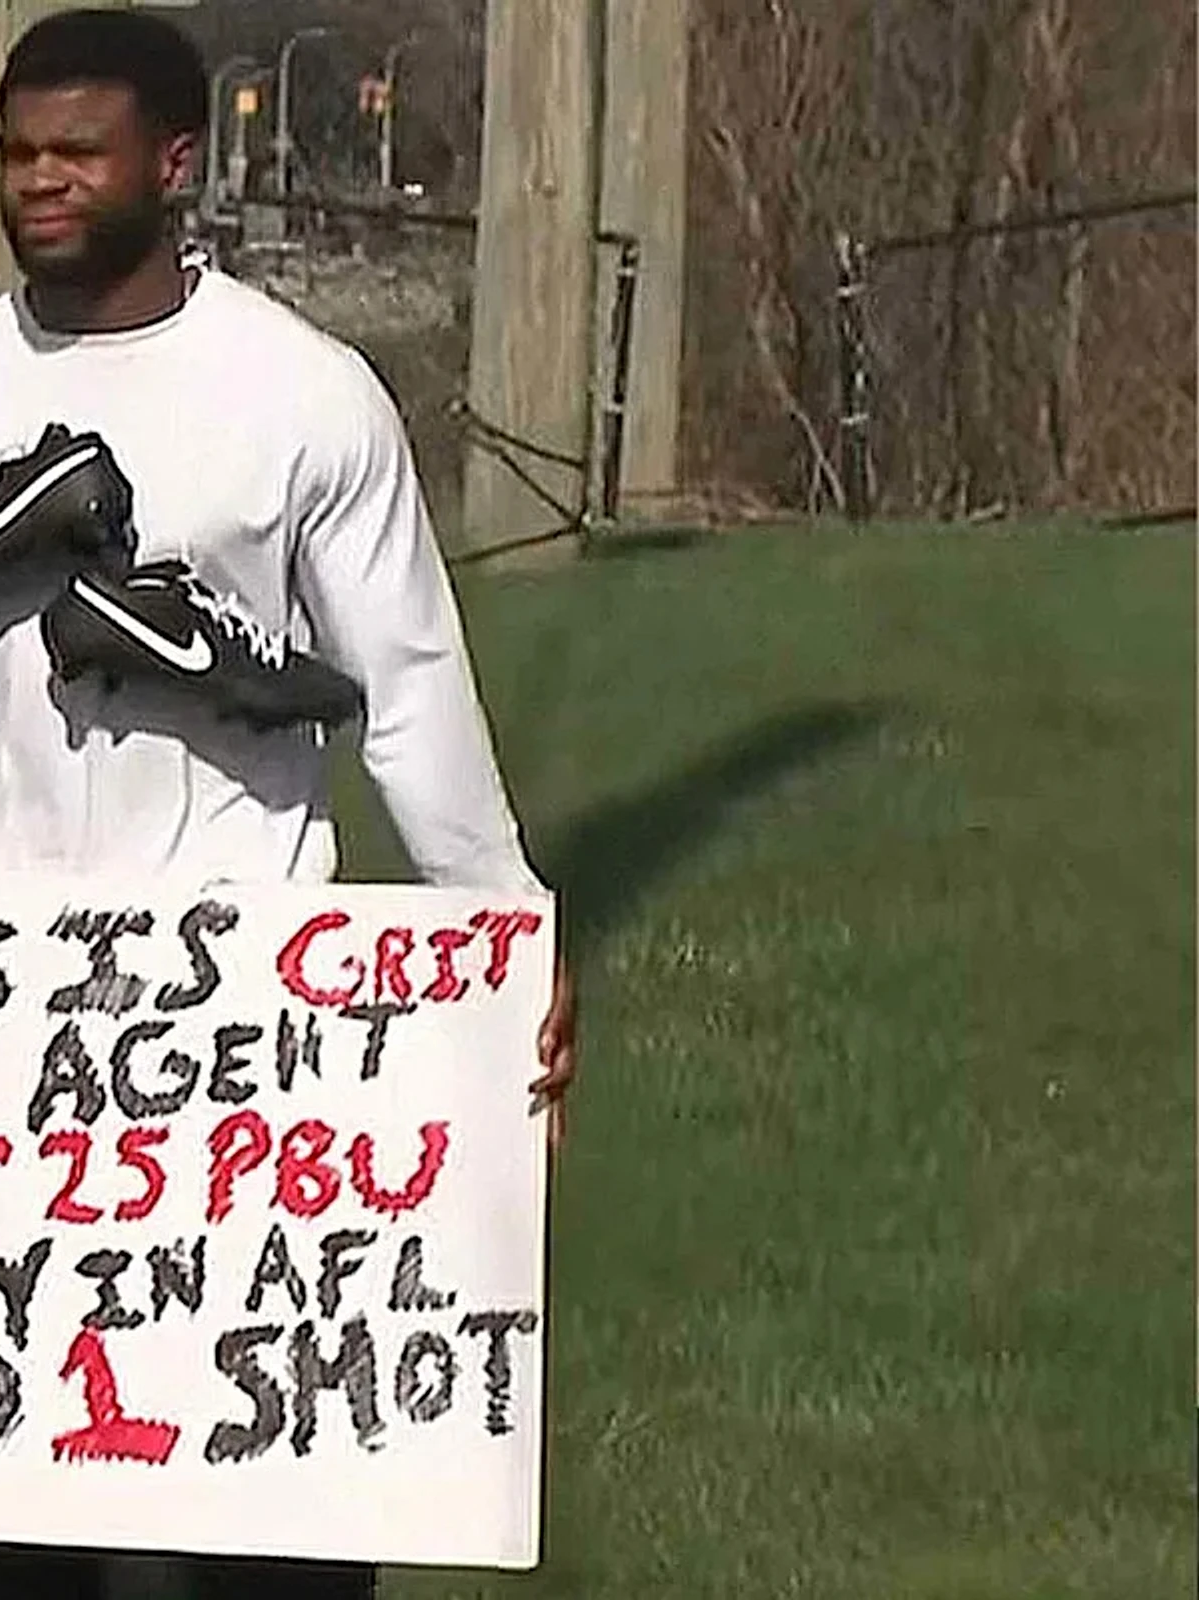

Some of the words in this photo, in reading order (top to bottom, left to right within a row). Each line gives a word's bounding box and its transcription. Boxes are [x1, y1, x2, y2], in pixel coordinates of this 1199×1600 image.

[46, 899, 240, 1014] IS
[276, 909, 541, 1007] GRIT
[39, 1127, 171, 1223] 25
[206, 1109, 450, 1224] PBU
[74, 1235, 205, 1332] IN
[246, 1223, 457, 1317] AFL
[51, 1320, 180, 1465] 1
[203, 1310, 537, 1465] SHOT
